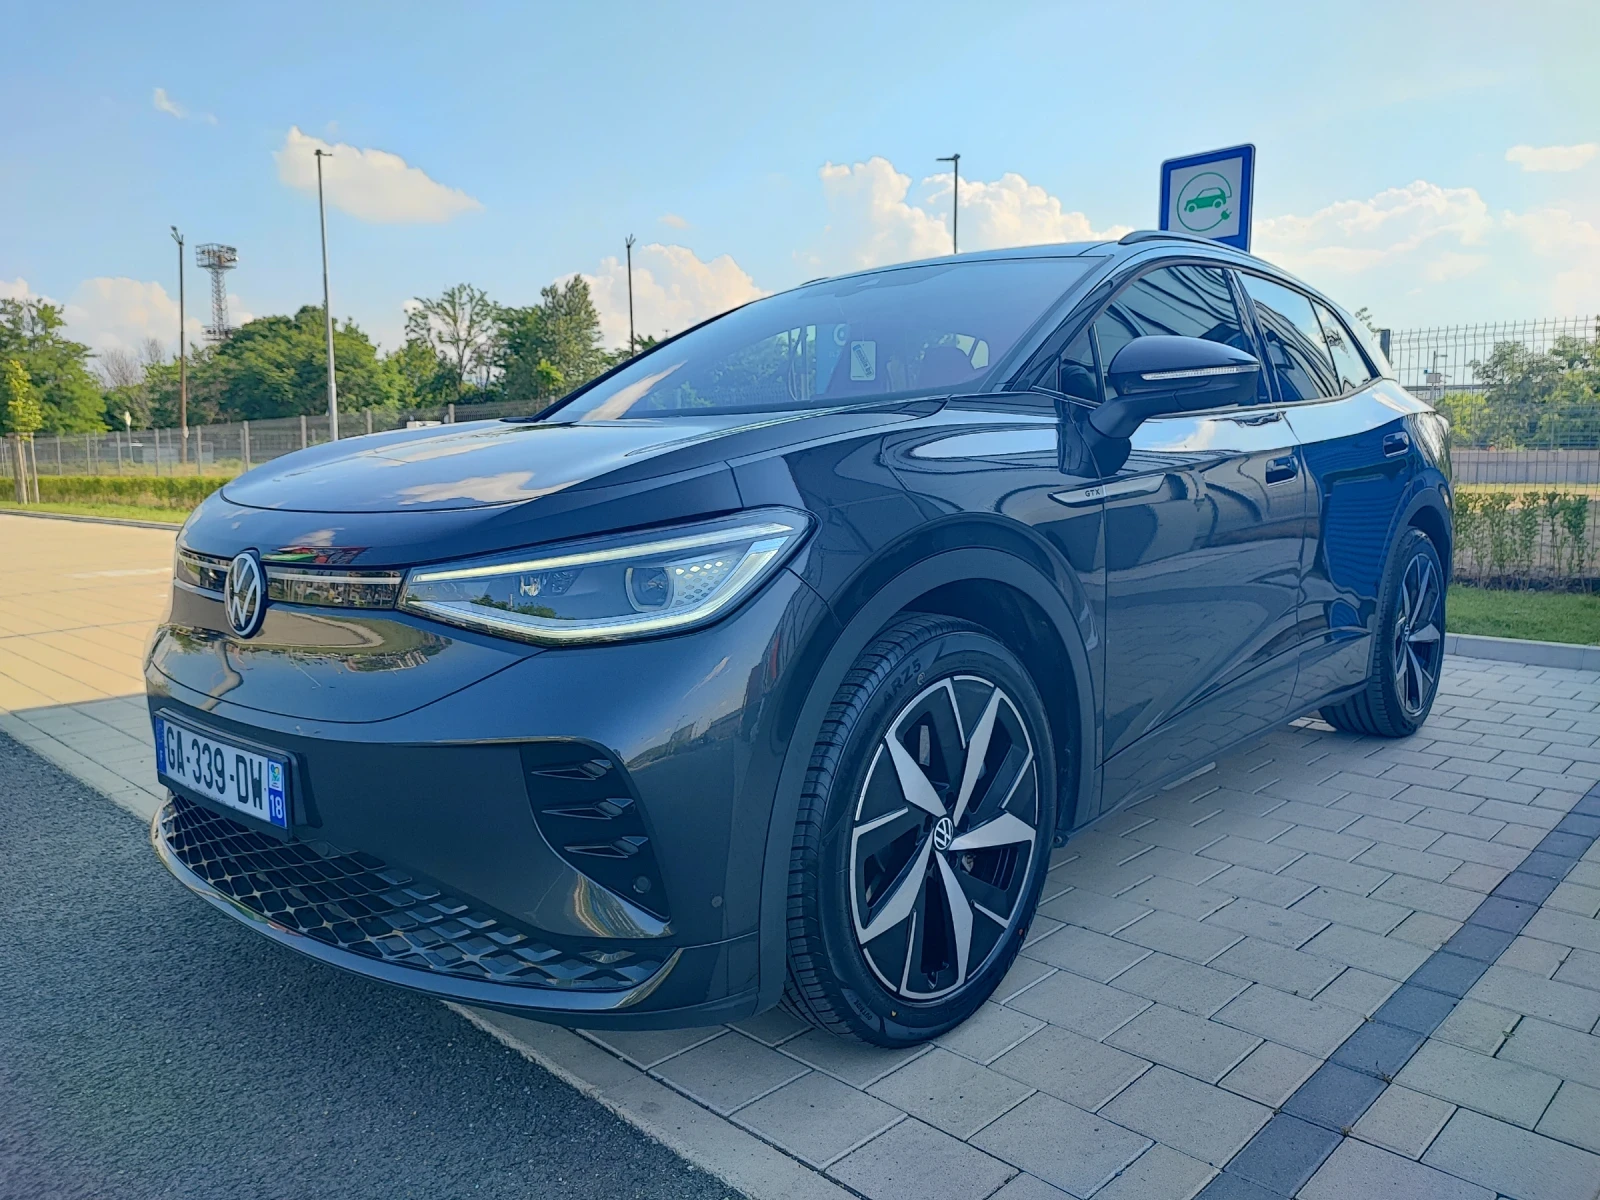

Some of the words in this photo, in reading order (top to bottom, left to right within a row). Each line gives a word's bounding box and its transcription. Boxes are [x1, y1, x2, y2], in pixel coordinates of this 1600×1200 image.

[1085, 488, 1100, 497] GTX
[166, 726, 263, 811] GA-339-DW
[269, 794, 283, 819] 18
[853, 999, 873, 1021] OUTSIDE
